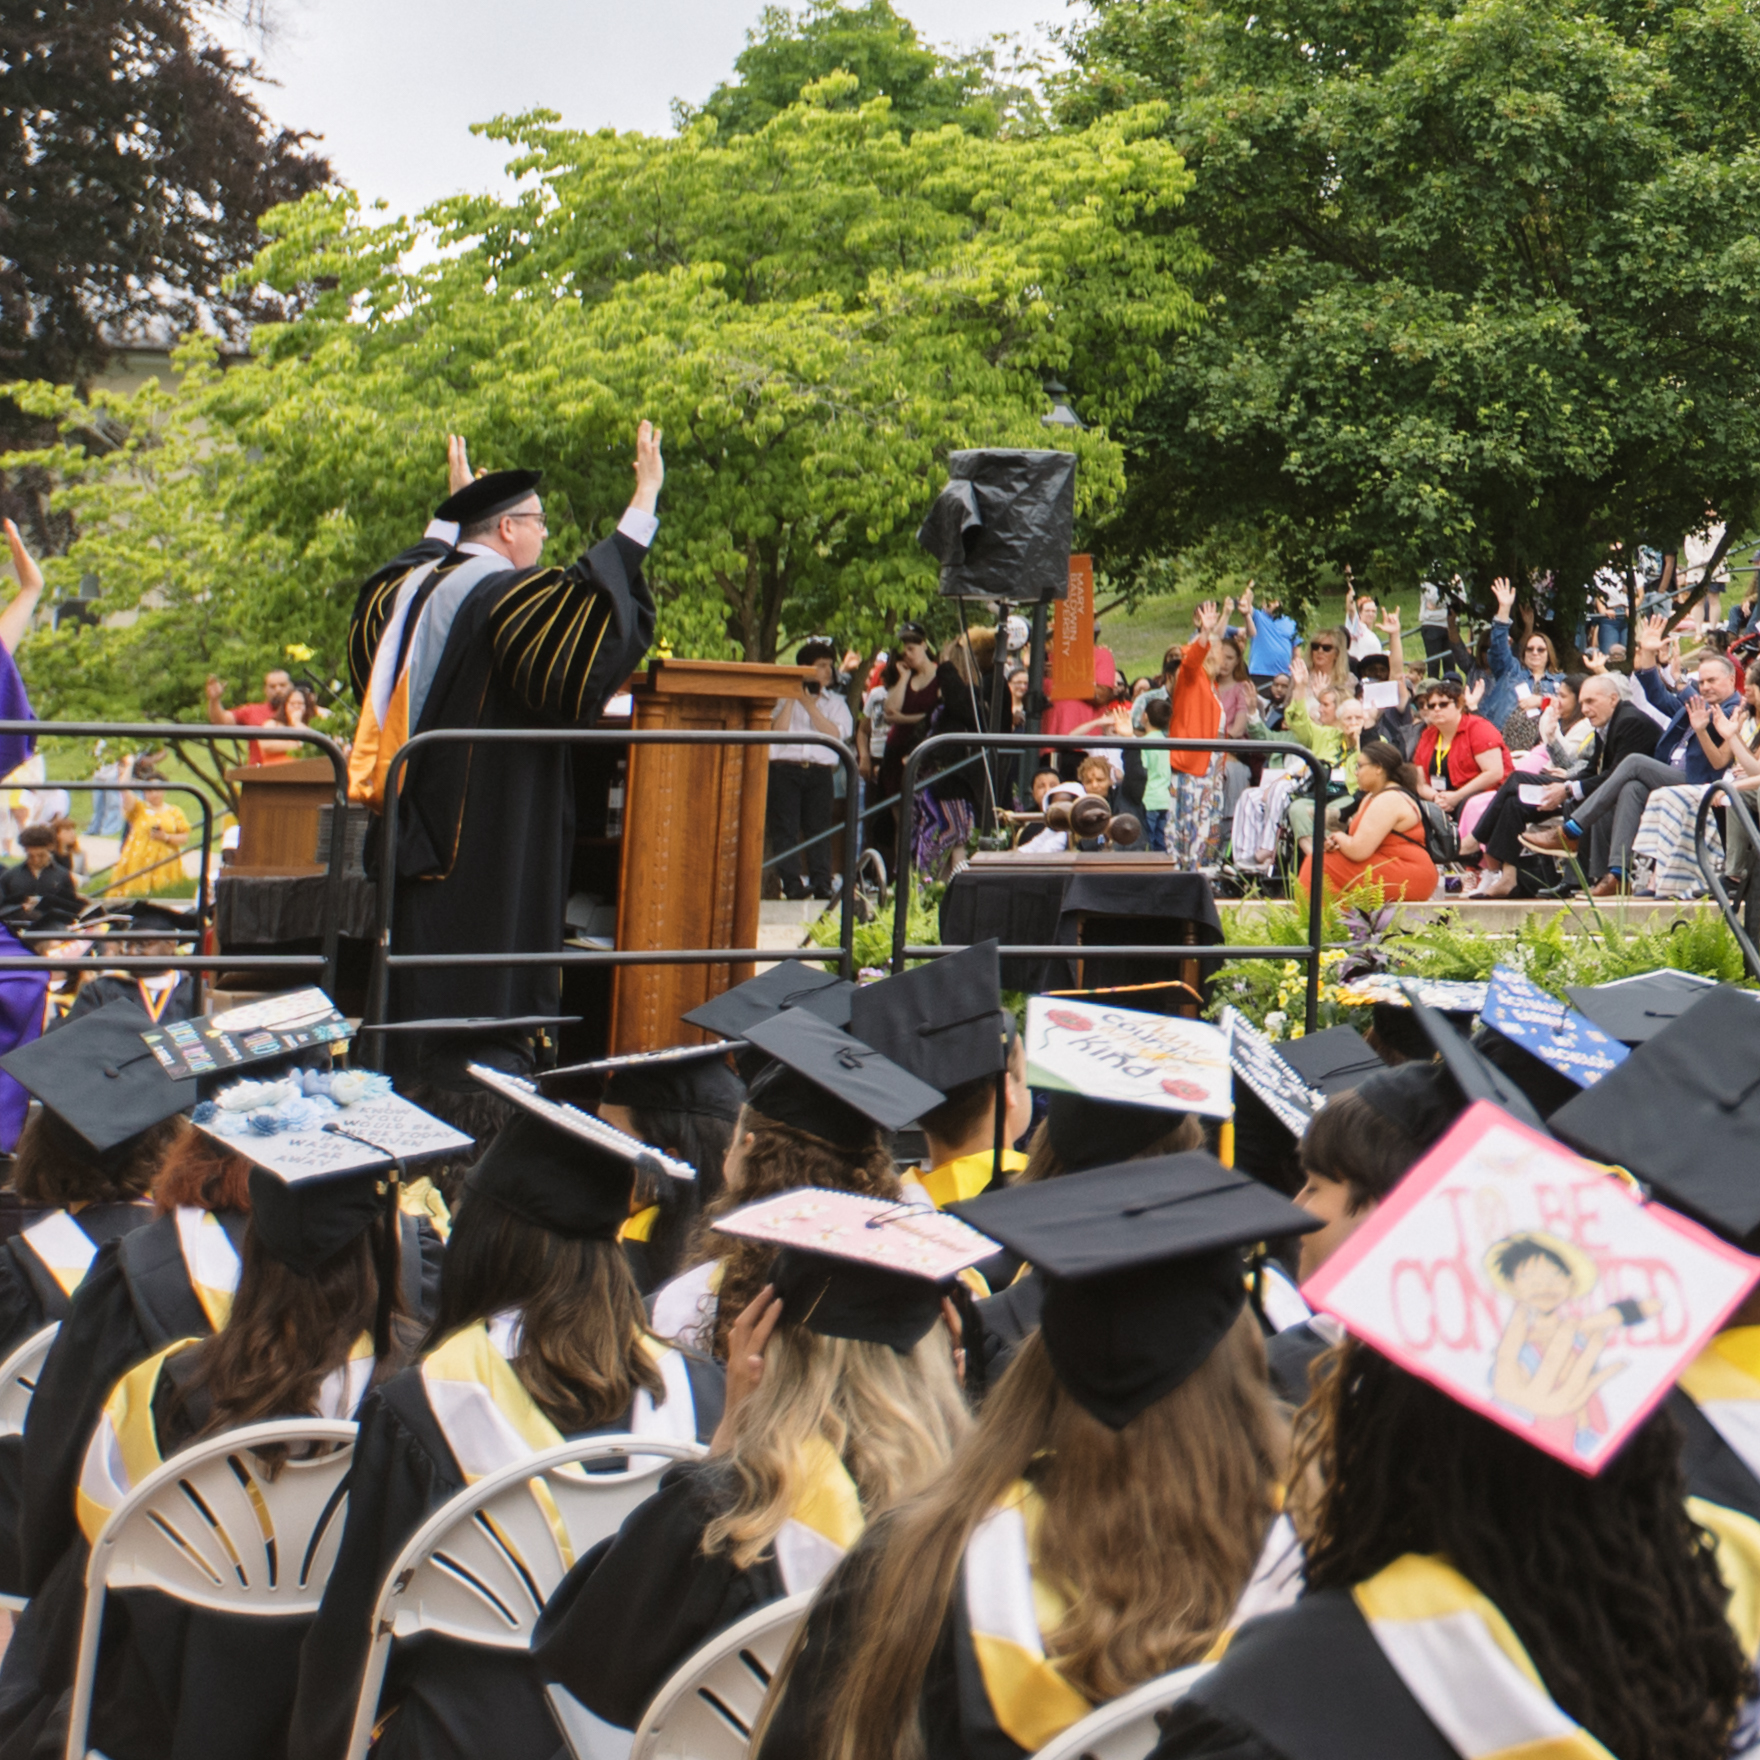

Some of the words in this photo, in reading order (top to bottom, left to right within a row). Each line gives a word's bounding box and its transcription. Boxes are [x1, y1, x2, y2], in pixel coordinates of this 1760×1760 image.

[1077, 572, 1085, 615] MARY
[359, 1106, 412, 1115] KNOW
[343, 1119, 405, 1130] WOULD
[400, 1131, 456, 1139] TODAY
[307, 1150, 344, 1159] FAR
[274, 1155, 332, 1167] AWAY
[1533, 1182, 1612, 1250] BE
[1390, 1257, 1690, 1354] CONUED
